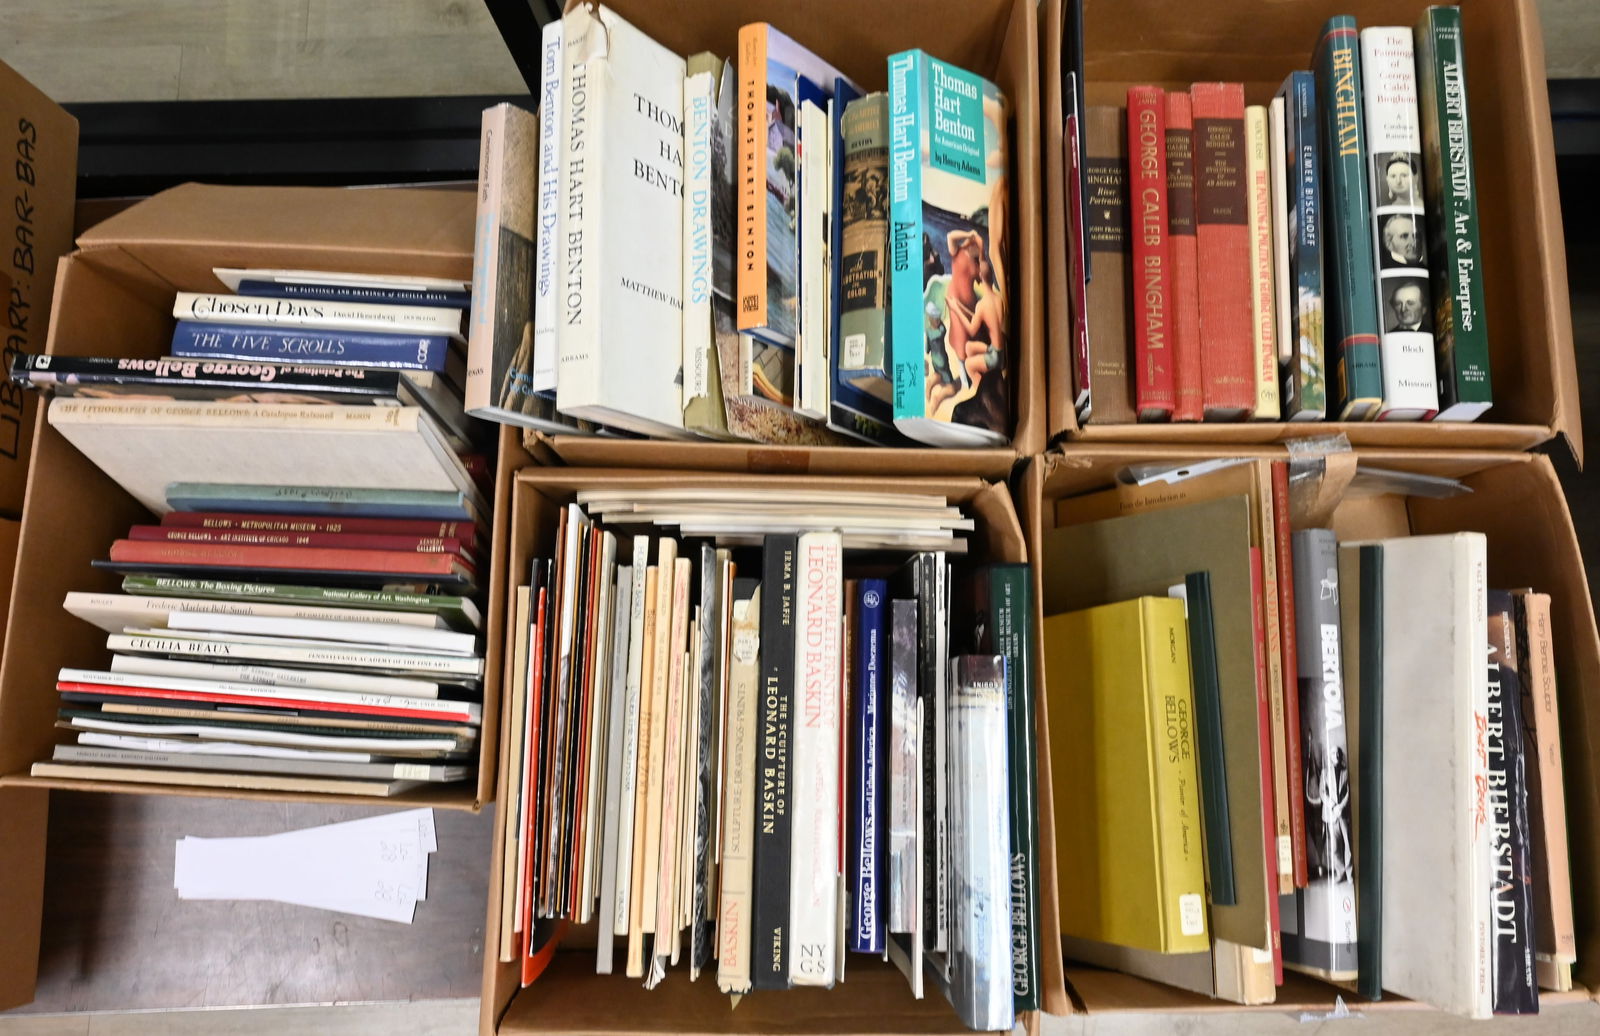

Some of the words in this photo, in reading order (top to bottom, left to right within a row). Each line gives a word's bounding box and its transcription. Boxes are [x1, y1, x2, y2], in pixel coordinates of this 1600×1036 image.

[546, 36, 560, 77] Tom
[1374, 49, 1414, 58] Paintings
[1387, 37, 1403, 46] The
[932, 62, 978, 100] Thomas
[1380, 72, 1412, 80] George
[1390, 60, 1400, 68] of
[892, 55, 914, 114] Thomas
[934, 86, 961, 116] Hart
[1333, 48, 1360, 158] BINGHAM
[1377, 95, 1417, 104] Bingham
[1384, 83, 1410, 92] Caleb
[1444, 60, 1463, 118] ALBERT
[545, 80, 560, 139] Benton
[570, 63, 587, 153] THOMAS
[746, 80, 754, 144] THOMAS
[934, 109, 976, 142] Benton
[692, 96, 708, 180] BENTON
[894, 112, 915, 150] Hart
[1140, 110, 1158, 180] GEORGE
[544, 144, 558, 175] and
[746, 152, 754, 196] HART
[894, 148, 915, 204] Benton
[934, 152, 942, 165] by
[942, 156, 961, 172] Henry
[961, 161, 981, 176] Adams
[1304, 146, 1313, 183] ELMER
[543, 180, 558, 210] His
[568, 160, 584, 220] HART
[1142, 188, 1160, 246] CALEB
[1305, 188, 1316, 247] BISCHOFF
[1454, 212, 1470, 234] Art
[538, 214, 557, 297] Drawings
[692, 190, 708, 304] DRAWINGS
[746, 204, 754, 271] BENTON
[894, 221, 916, 272] Adams
[1456, 238, 1472, 253] &
[567, 232, 583, 326] BENTON
[620, 276, 668, 302] MATTHEW
[1260, 282, 1271, 312] GEORGE
[1456, 258, 1477, 332] Enterprise
[191, 296, 272, 321] Chosen
[274, 300, 324, 322] Days
[1144, 256, 1164, 350] BINGHAM
[192, 332, 222, 348] THE
[232, 335, 271, 350] FIVE
[278, 337, 345, 354] SCROLLS
[1262, 315, 1272, 342] CALEB
[118, 358, 200, 378] Bellows
[561, 354, 590, 363] ABRAMS
[1262, 344, 1274, 382] BINGHAM
[1402, 346, 1424, 354] Bloch
[1, 283, 31, 460] LIBARY:
[202, 362, 276, 382] George
[280, 366, 291, 376] of
[292, 366, 344, 379] Paintings
[348, 369, 364, 380] The
[1398, 380, 1432, 388] Missouri
[1134, 499, 1143, 507] the
[1144, 493, 1178, 506] Introduction
[167, 532, 187, 540] GEORGE
[188, 533, 212, 541] BELLOWS
[220, 534, 230, 542] ART
[266, 536, 289, 544] CHICAGO
[204, 518, 232, 528] BELLOWS
[241, 520, 288, 530] METROPOLITAN
[290, 522, 316, 532] MUSEUM
[784, 550, 792, 580] IRMA
[826, 544, 838, 574] THE
[156, 578, 196, 588] BELLOWS:
[200, 580, 214, 590] The
[216, 582, 242, 593] Boxing
[243, 584, 276, 594] Pictures
[323, 590, 348, 599] National
[350, 591, 372, 601] Gallery
[373, 592, 380, 600] of
[394, 594, 430, 604] Washington
[783, 584, 791, 593] B.
[806, 544, 824, 648] LEONARD
[782, 596, 791, 626] JAFFE
[824, 576, 838, 653] COMPLETE
[1266, 580, 1278, 654] INDIANS
[1538, 612, 1546, 638] Harry
[130, 639, 182, 651] CECILIA
[188, 644, 232, 654] BEAUX
[1168, 627, 1176, 664] MORGAN
[1502, 610, 1512, 659] HENDRICKS
[308, 652, 357, 662] PENNSYLVANIA
[360, 656, 390, 664] ACADEMY
[1539, 640, 1548, 674] Bertoia
[804, 652, 822, 728] BASKIN
[823, 655, 836, 704] PRINTS
[867, 672, 876, 714] Marianne
[1320, 624, 1342, 730] BERTOIA
[1542, 676, 1552, 714] Sculptor
[736, 682, 746, 737] PRINTS
[765, 676, 779, 760] LEONARD
[779, 696, 788, 720] THE
[824, 707, 835, 728] OF
[866, 726, 874, 766] America
[1165, 696, 1180, 764] BELLOWS
[1178, 699, 1190, 760] GEORGE
[734, 744, 744, 792] DRAWINGS
[778, 722, 786, 796] SCULPTURE
[762, 768, 776, 834] BASKIN
[866, 768, 874, 796] Urban
[776, 801, 785, 816] OF
[866, 798, 874, 814] and
[860, 817, 874, 878] Bellows
[1488, 768, 1517, 944] BIERSTADT
[1010, 852, 1027, 926] BELLOWS
[860, 882, 873, 940] George
[724, 901, 737, 966] BASKIN
[772, 927, 782, 972] VIKING
[1012, 929, 1029, 997] GEORGE
